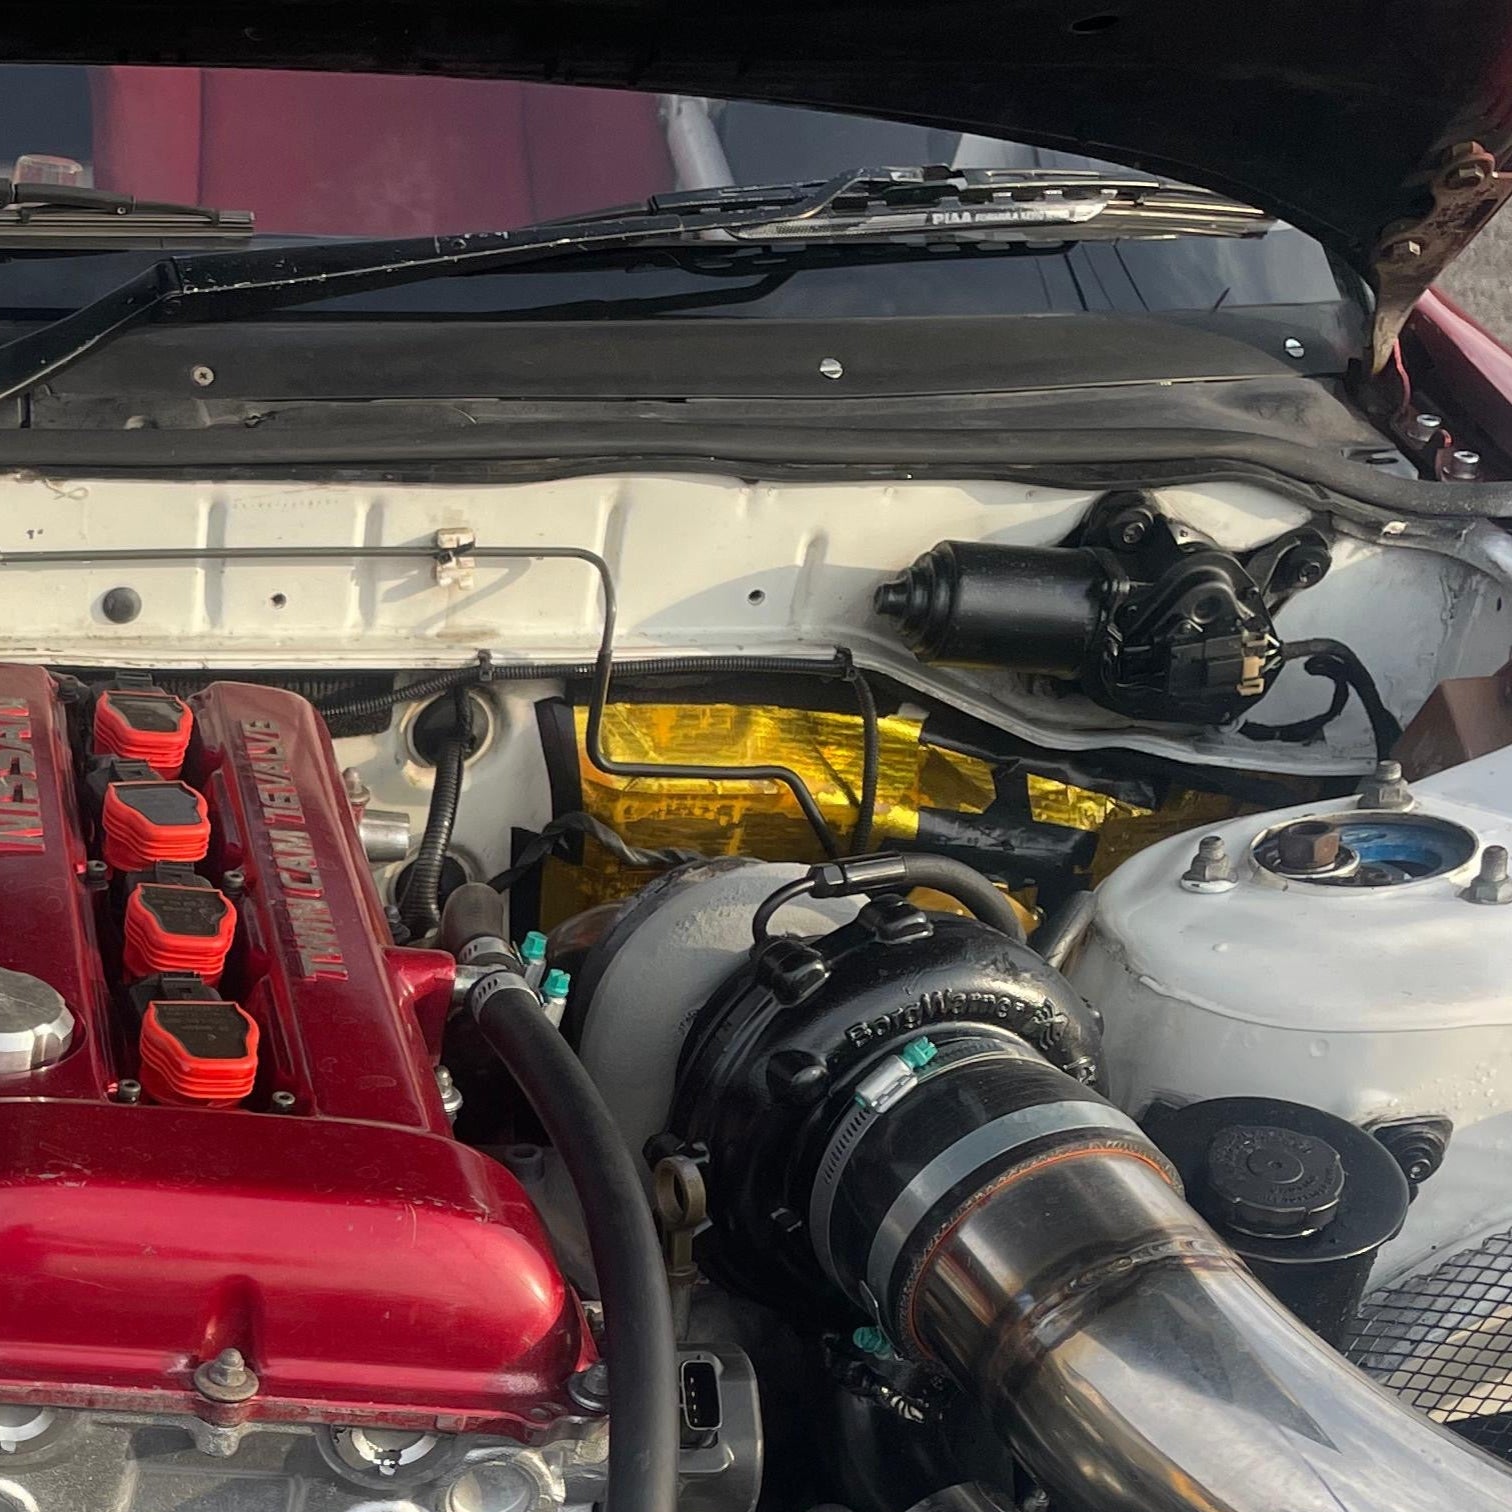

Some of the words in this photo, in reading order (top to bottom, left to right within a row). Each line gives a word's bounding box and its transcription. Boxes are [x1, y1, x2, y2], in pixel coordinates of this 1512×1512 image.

[932, 212, 972, 225] PIAA
[267, 828, 325, 897] CAM
[285, 897, 349, 981] TWIN
[844, 987, 1025, 1048] BorgWarner
